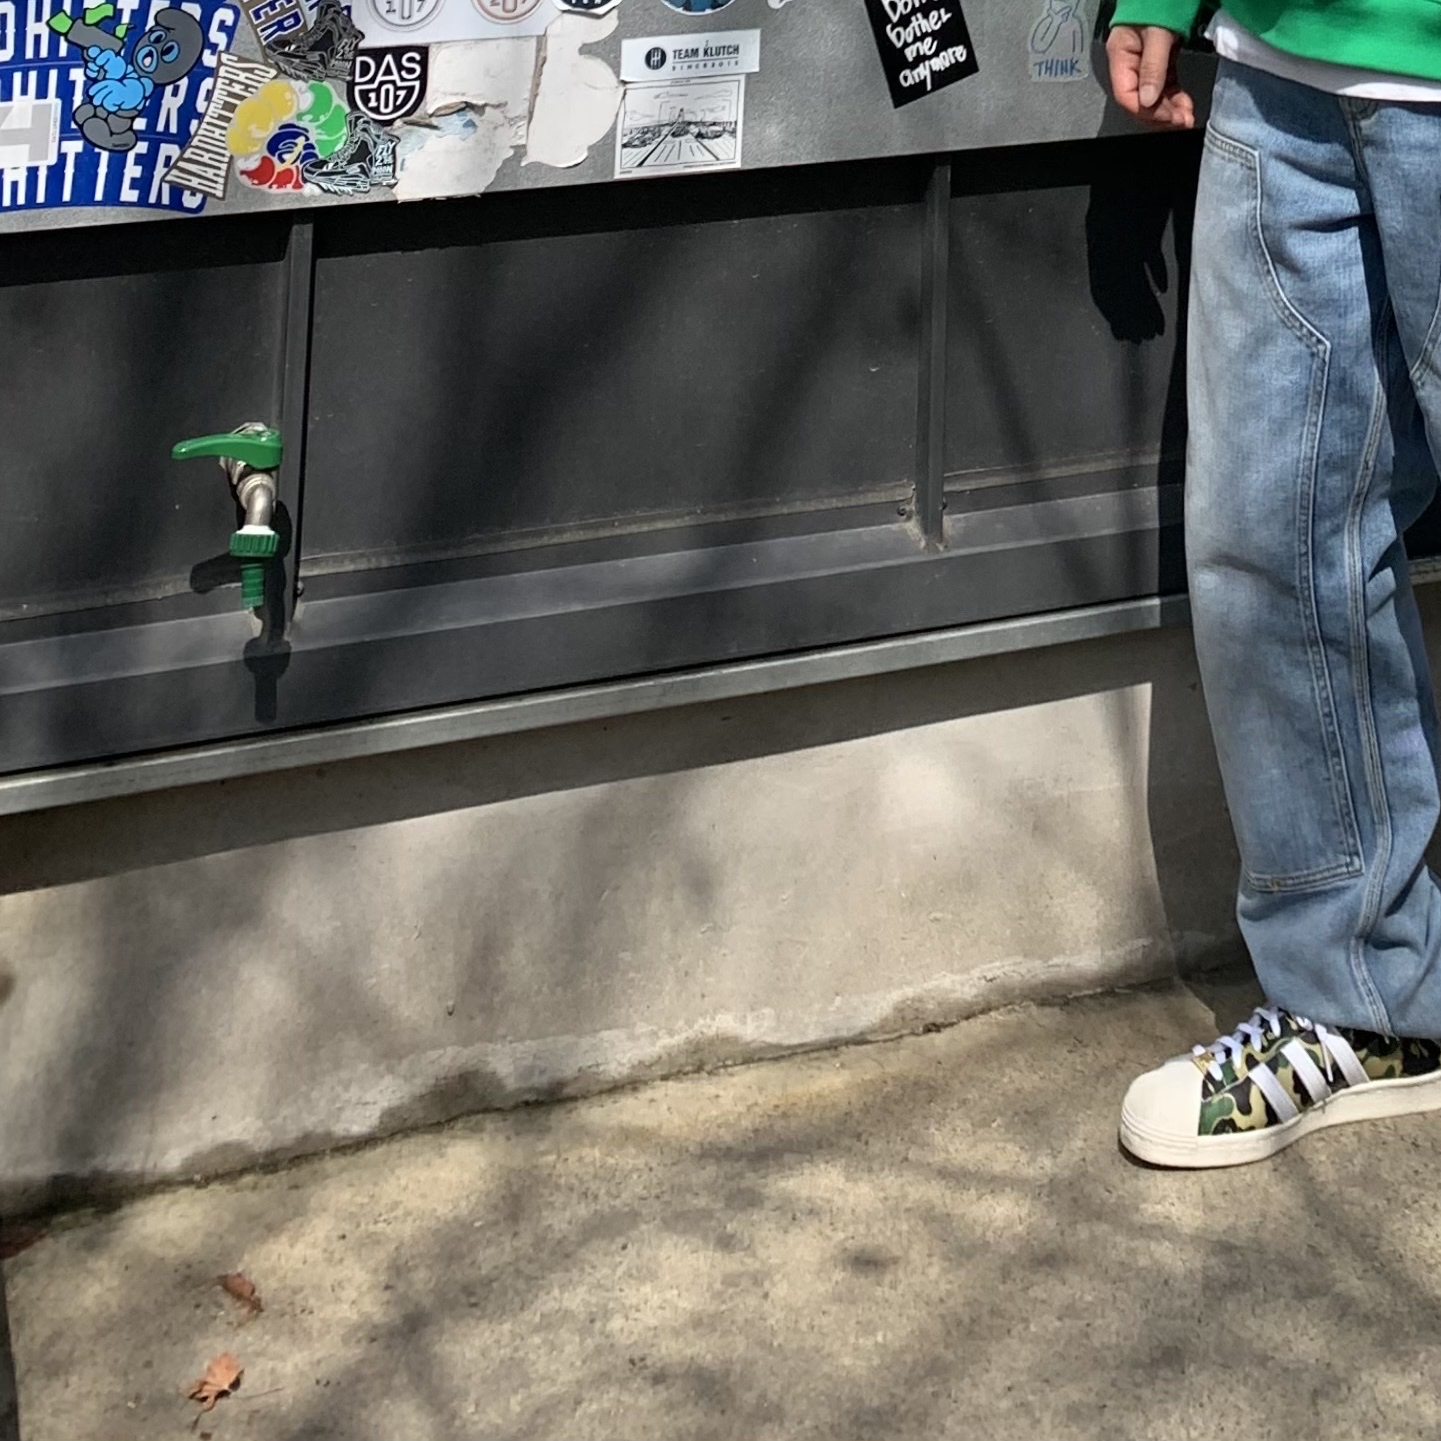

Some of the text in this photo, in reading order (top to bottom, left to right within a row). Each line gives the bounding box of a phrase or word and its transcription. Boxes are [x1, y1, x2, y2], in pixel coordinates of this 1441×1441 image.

[672, 43, 740, 60] TEAM KLUTCH
[355, 53, 422, 78] DAS
[1033, 61, 1081, 77] THINK
